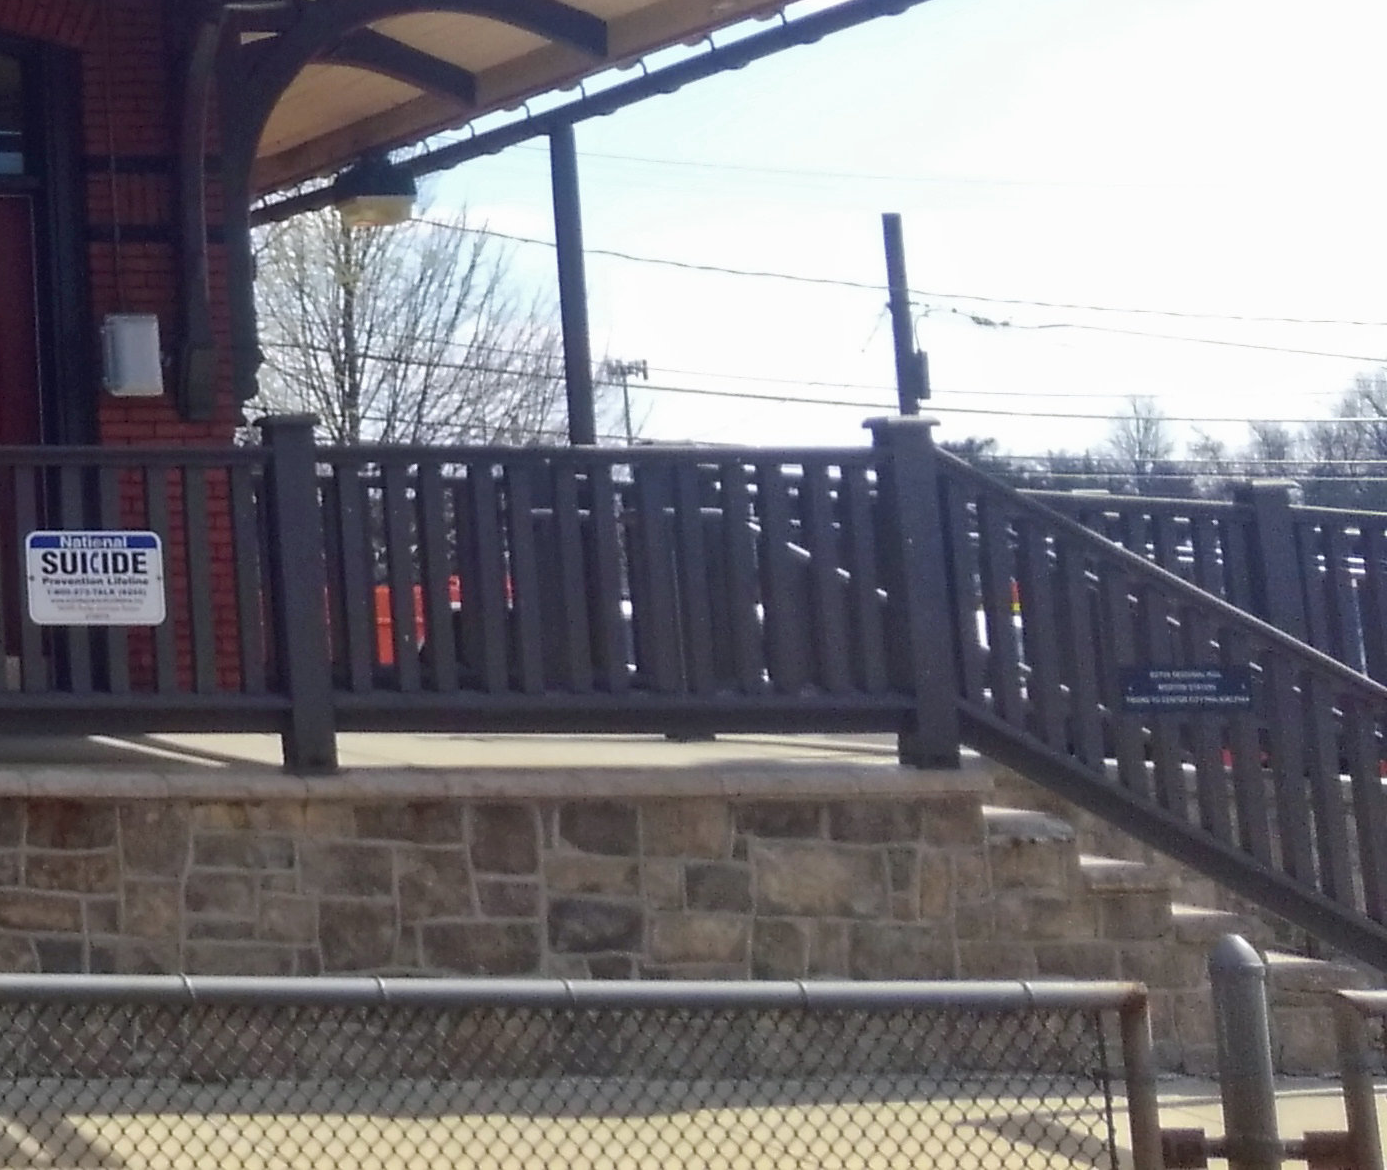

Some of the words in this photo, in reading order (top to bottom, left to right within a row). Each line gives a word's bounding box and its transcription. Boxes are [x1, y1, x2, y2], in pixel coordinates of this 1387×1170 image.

[59, 534, 127, 549] National
[41, 551, 149, 575] SUICIDE
[42, 577, 104, 586] Prevention
